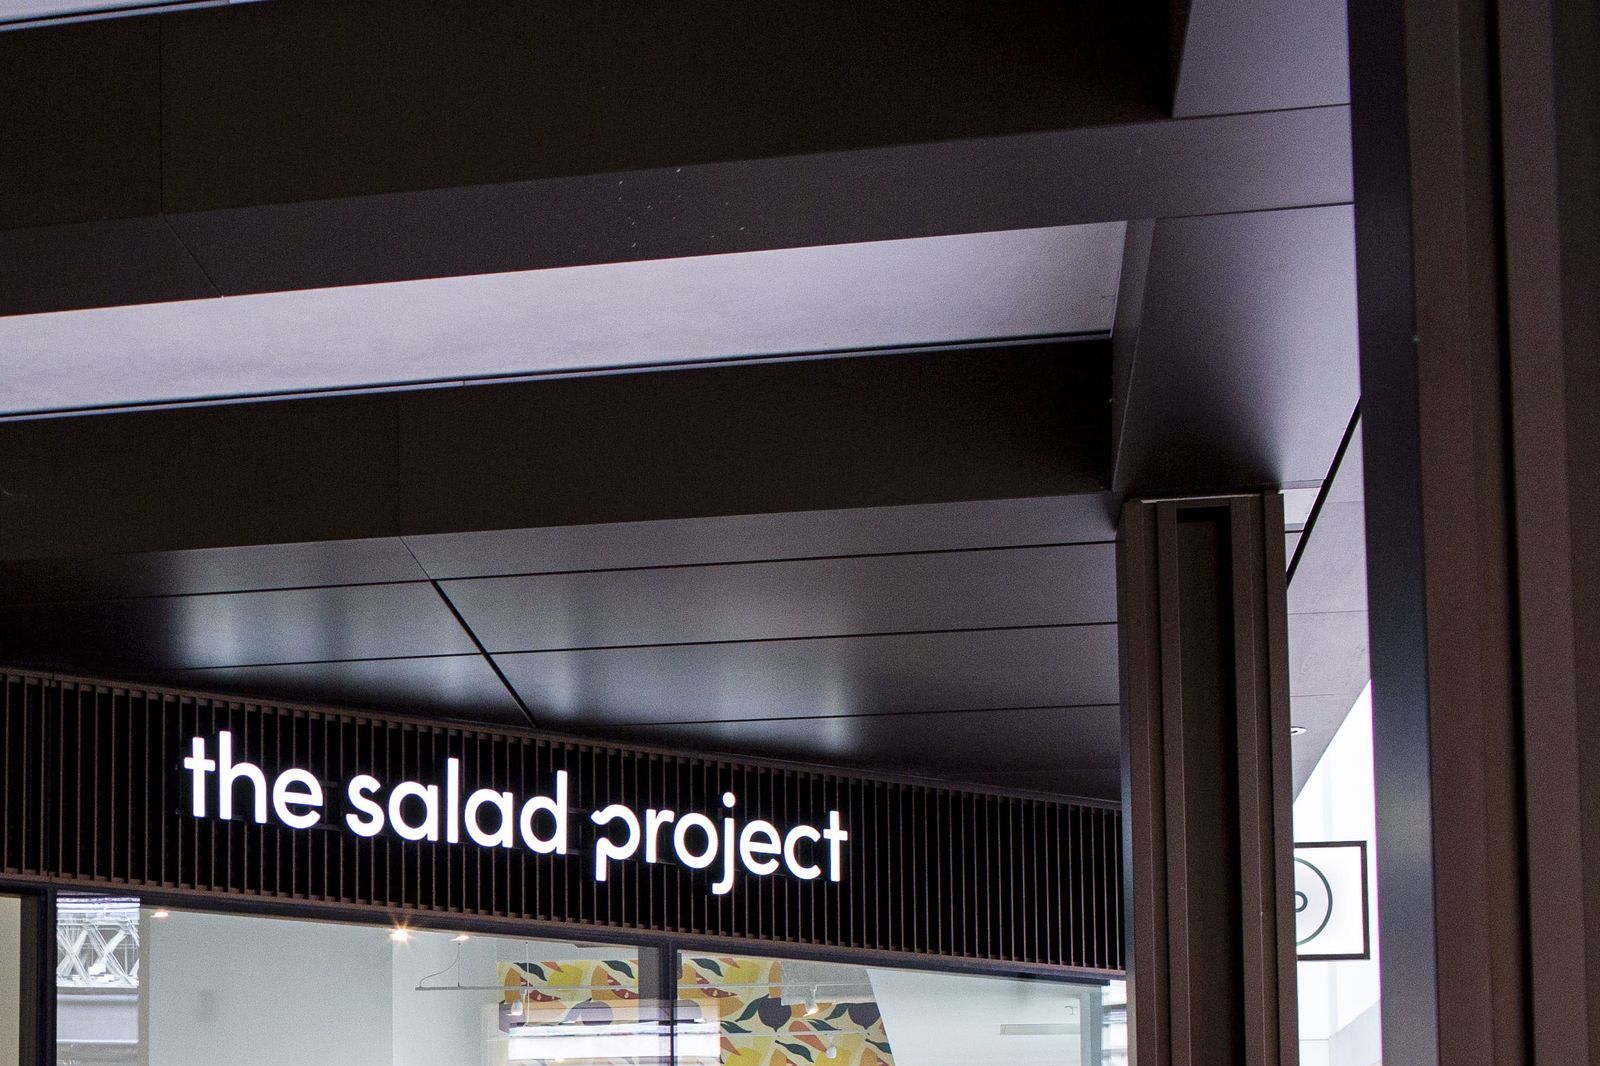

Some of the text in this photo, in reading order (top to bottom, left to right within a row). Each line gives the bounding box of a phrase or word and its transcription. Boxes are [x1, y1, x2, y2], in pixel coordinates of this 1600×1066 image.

[184, 731, 848, 895] the salad project
